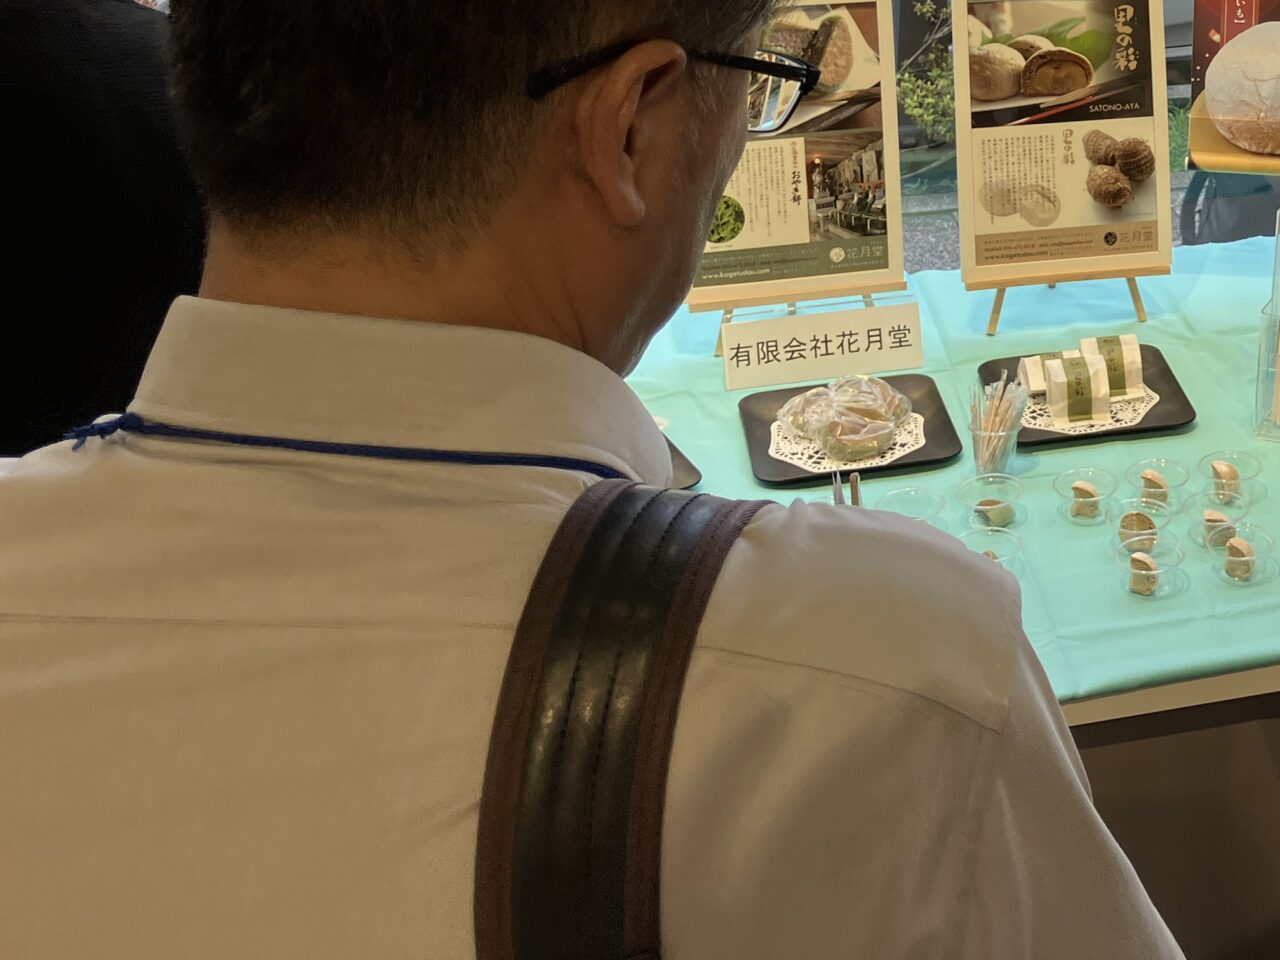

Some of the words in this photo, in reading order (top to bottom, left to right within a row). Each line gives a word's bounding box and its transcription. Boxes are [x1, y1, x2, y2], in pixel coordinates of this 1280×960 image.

[1088, 102, 1140, 114] SATONO-AYA
[729, 324, 913, 369] 有限会社花月堂
